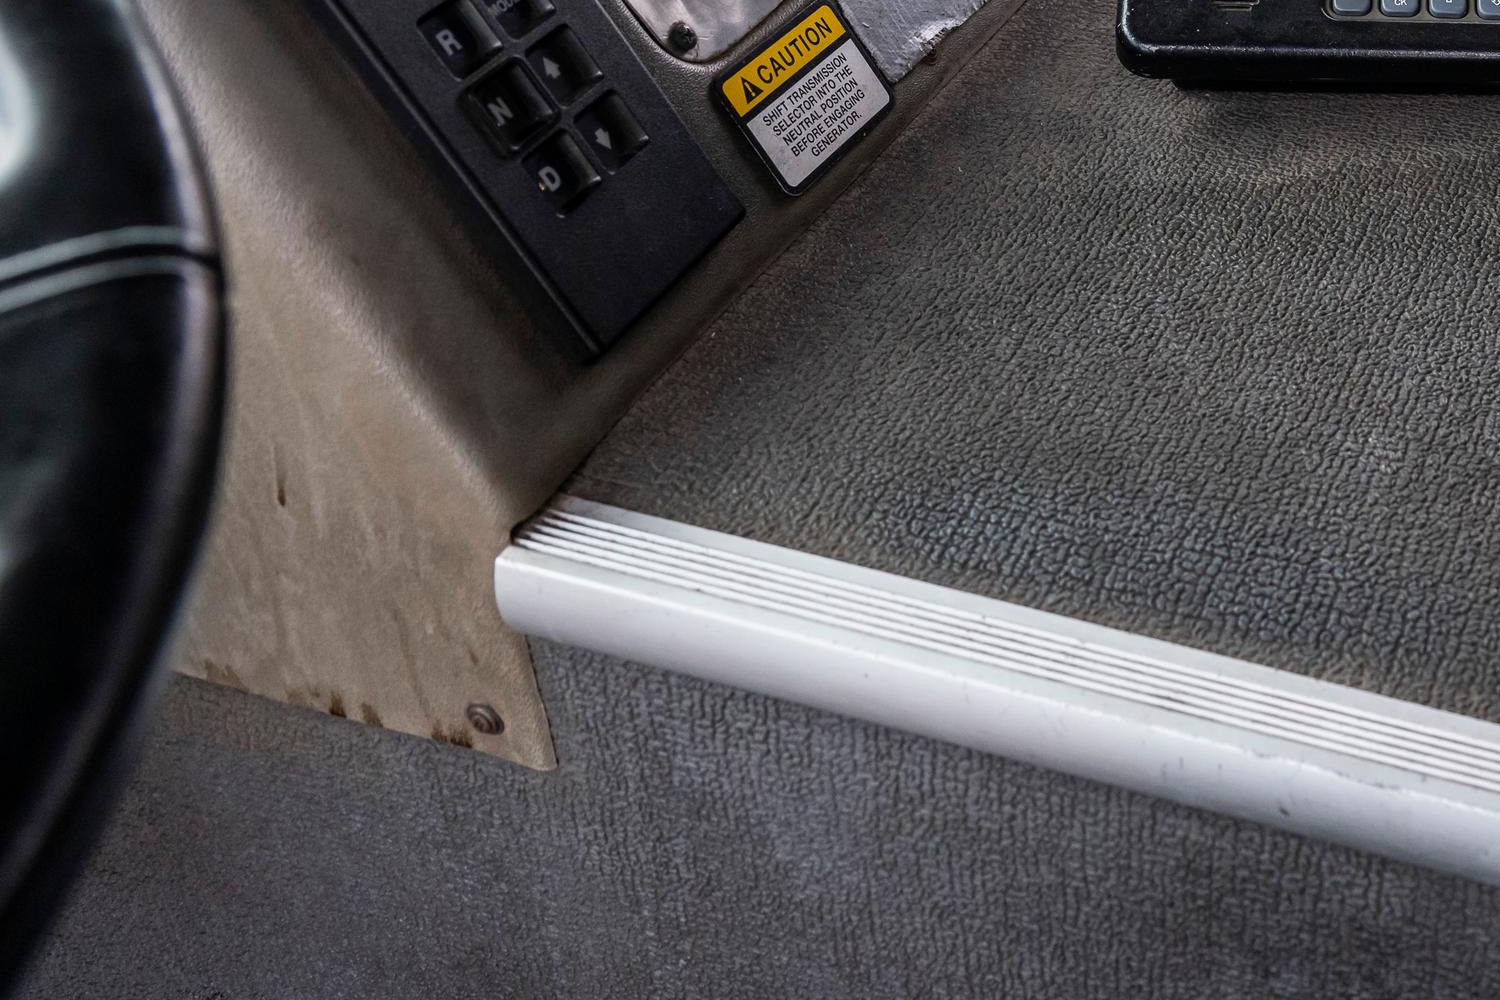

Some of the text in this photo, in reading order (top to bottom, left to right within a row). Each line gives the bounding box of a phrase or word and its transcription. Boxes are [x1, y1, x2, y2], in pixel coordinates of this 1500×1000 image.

[435, 28, 463, 56] R
[756, 17, 832, 84] CAUTION
[487, 96, 514, 126] N
[762, 52, 848, 127] SHIFT TRANSMISSION
[772, 64, 854, 136] SELECTOR INTO THE
[782, 77, 858, 146] NEUTRAL POSITION
[792, 88, 866, 157] BEFORE ENGAGING
[811, 110, 863, 157] GENERATOR.
[538, 166, 561, 192] D
